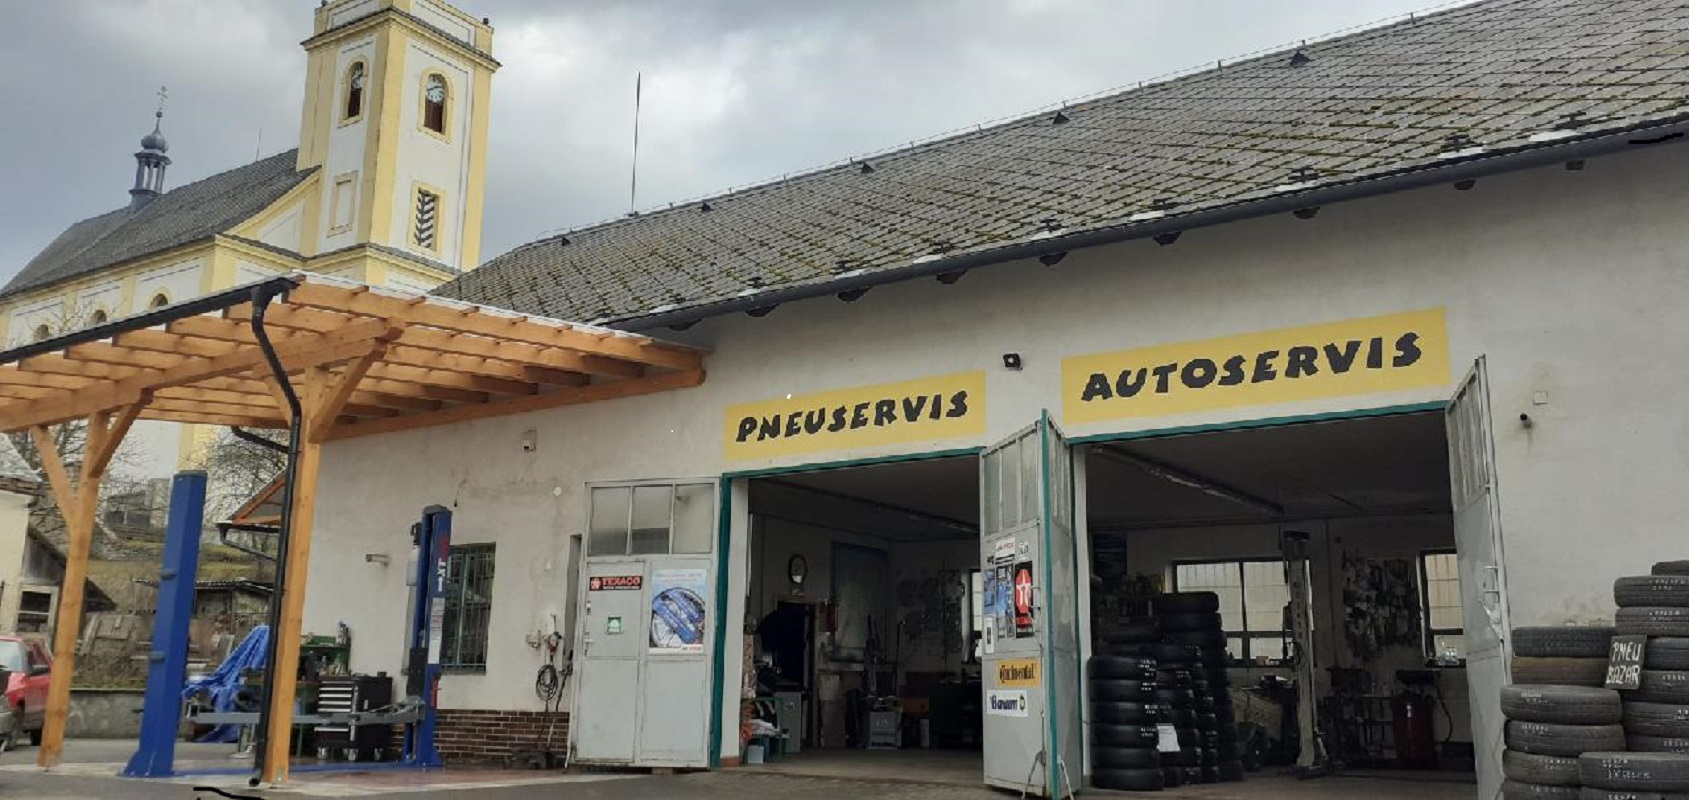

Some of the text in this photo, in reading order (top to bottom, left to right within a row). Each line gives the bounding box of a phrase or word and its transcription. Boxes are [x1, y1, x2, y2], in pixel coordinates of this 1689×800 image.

[1081, 332, 1422, 401] AUTOSERVIS
[736, 390, 968, 442] PNEUSERVIS
[602, 576, 641, 586] TEXACO
[1612, 641, 1642, 661] PNEU
[1605, 664, 1640, 685] BAZAR
